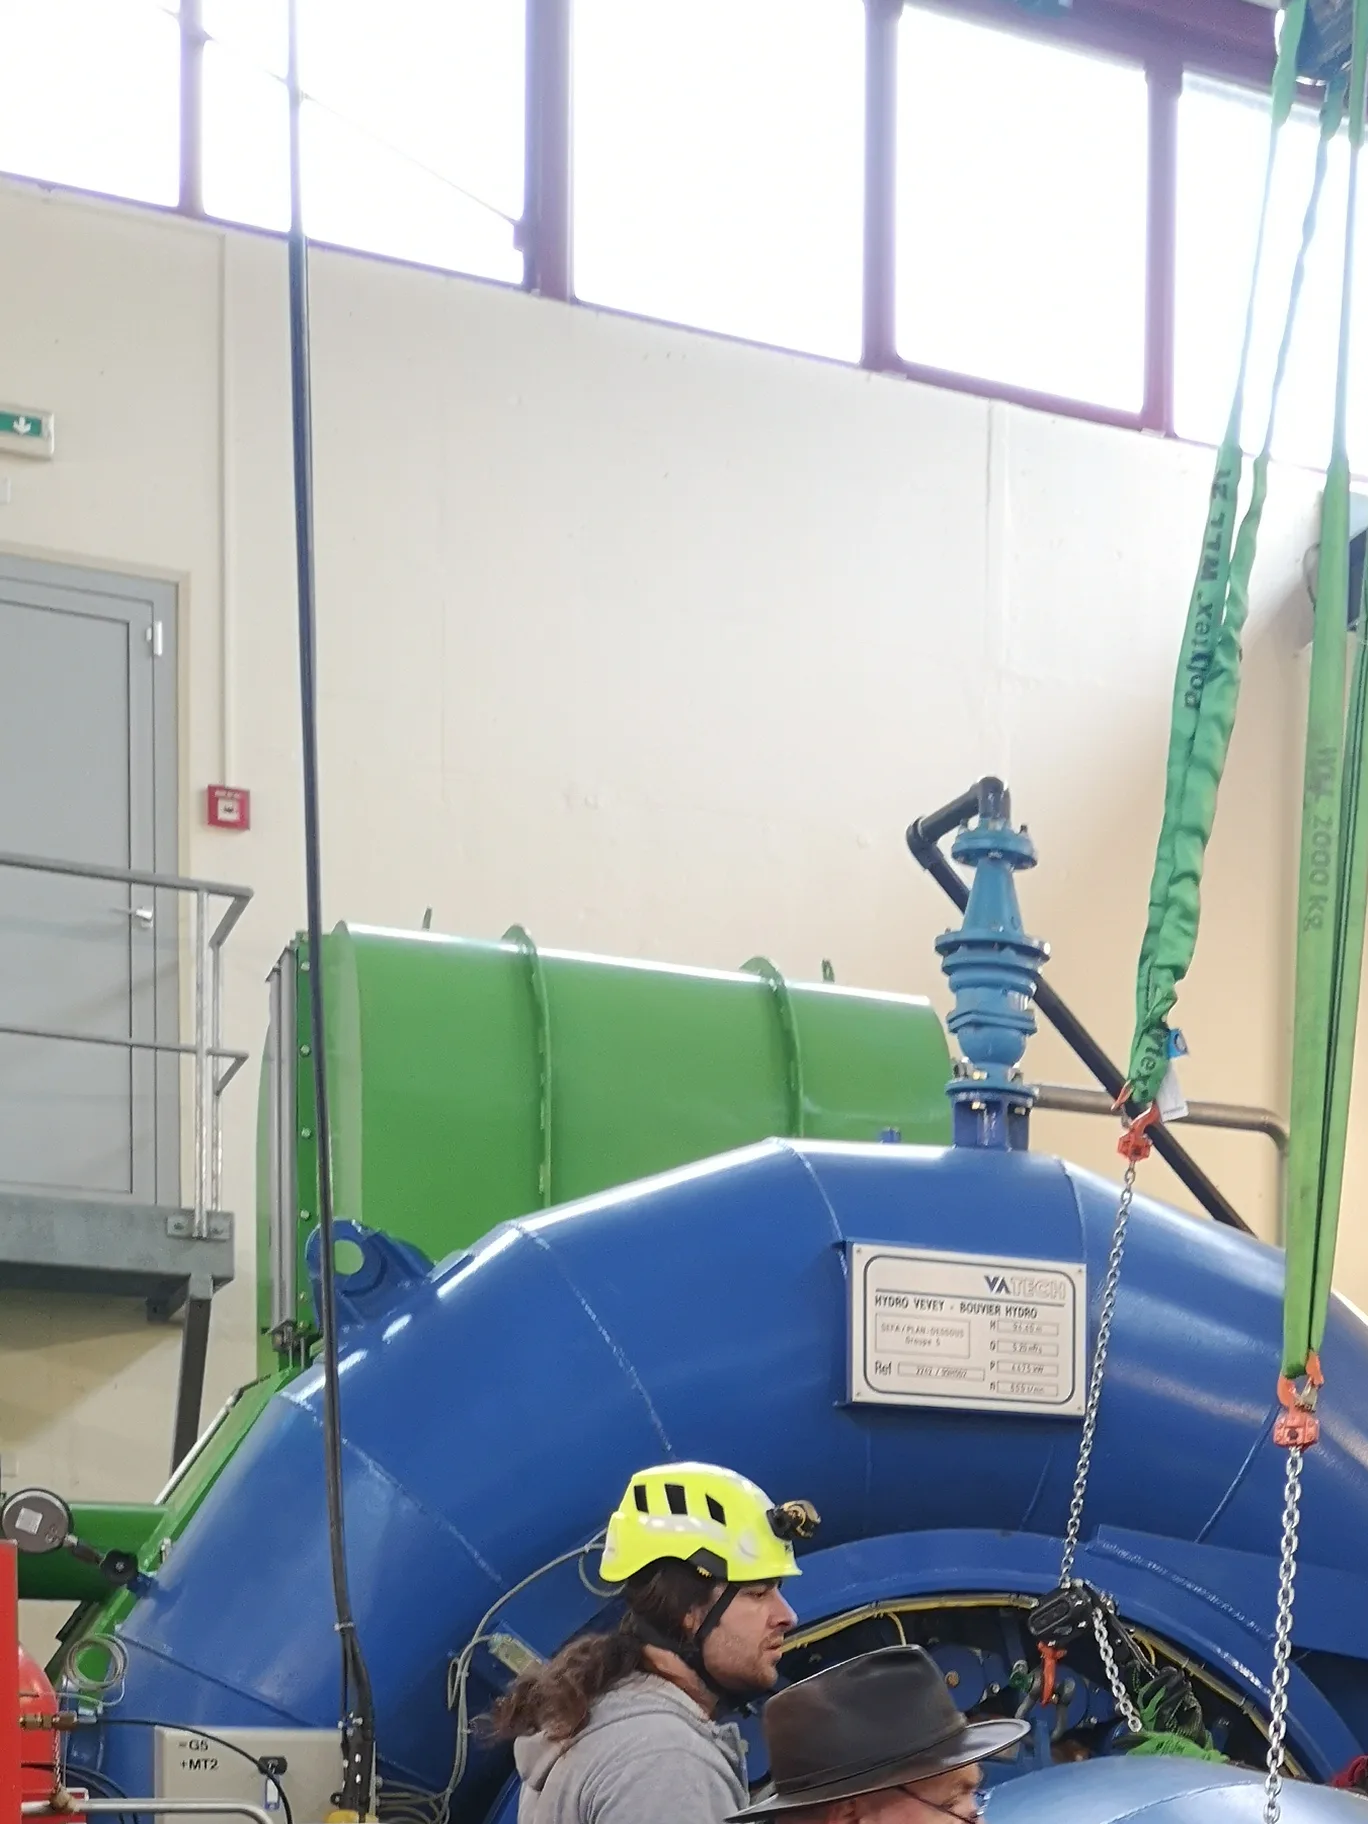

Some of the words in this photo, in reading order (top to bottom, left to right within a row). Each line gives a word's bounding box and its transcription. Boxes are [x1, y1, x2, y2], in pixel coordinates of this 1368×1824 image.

[1201, 512, 1226, 581] WLL
[1309, 814, 1333, 887] 2000
[1302, 894, 1329, 932] kg
[874, 1294, 909, 1309] HYDRO
[913, 1297, 945, 1312] VEVEY
[959, 1302, 1001, 1316] BOUVIER
[1005, 1306, 1038, 1319] HYDRO
[874, 1360, 892, 1376] Ref
[989, 1360, 996, 1371] P
[180, 1757, 219, 1771] +MT2
